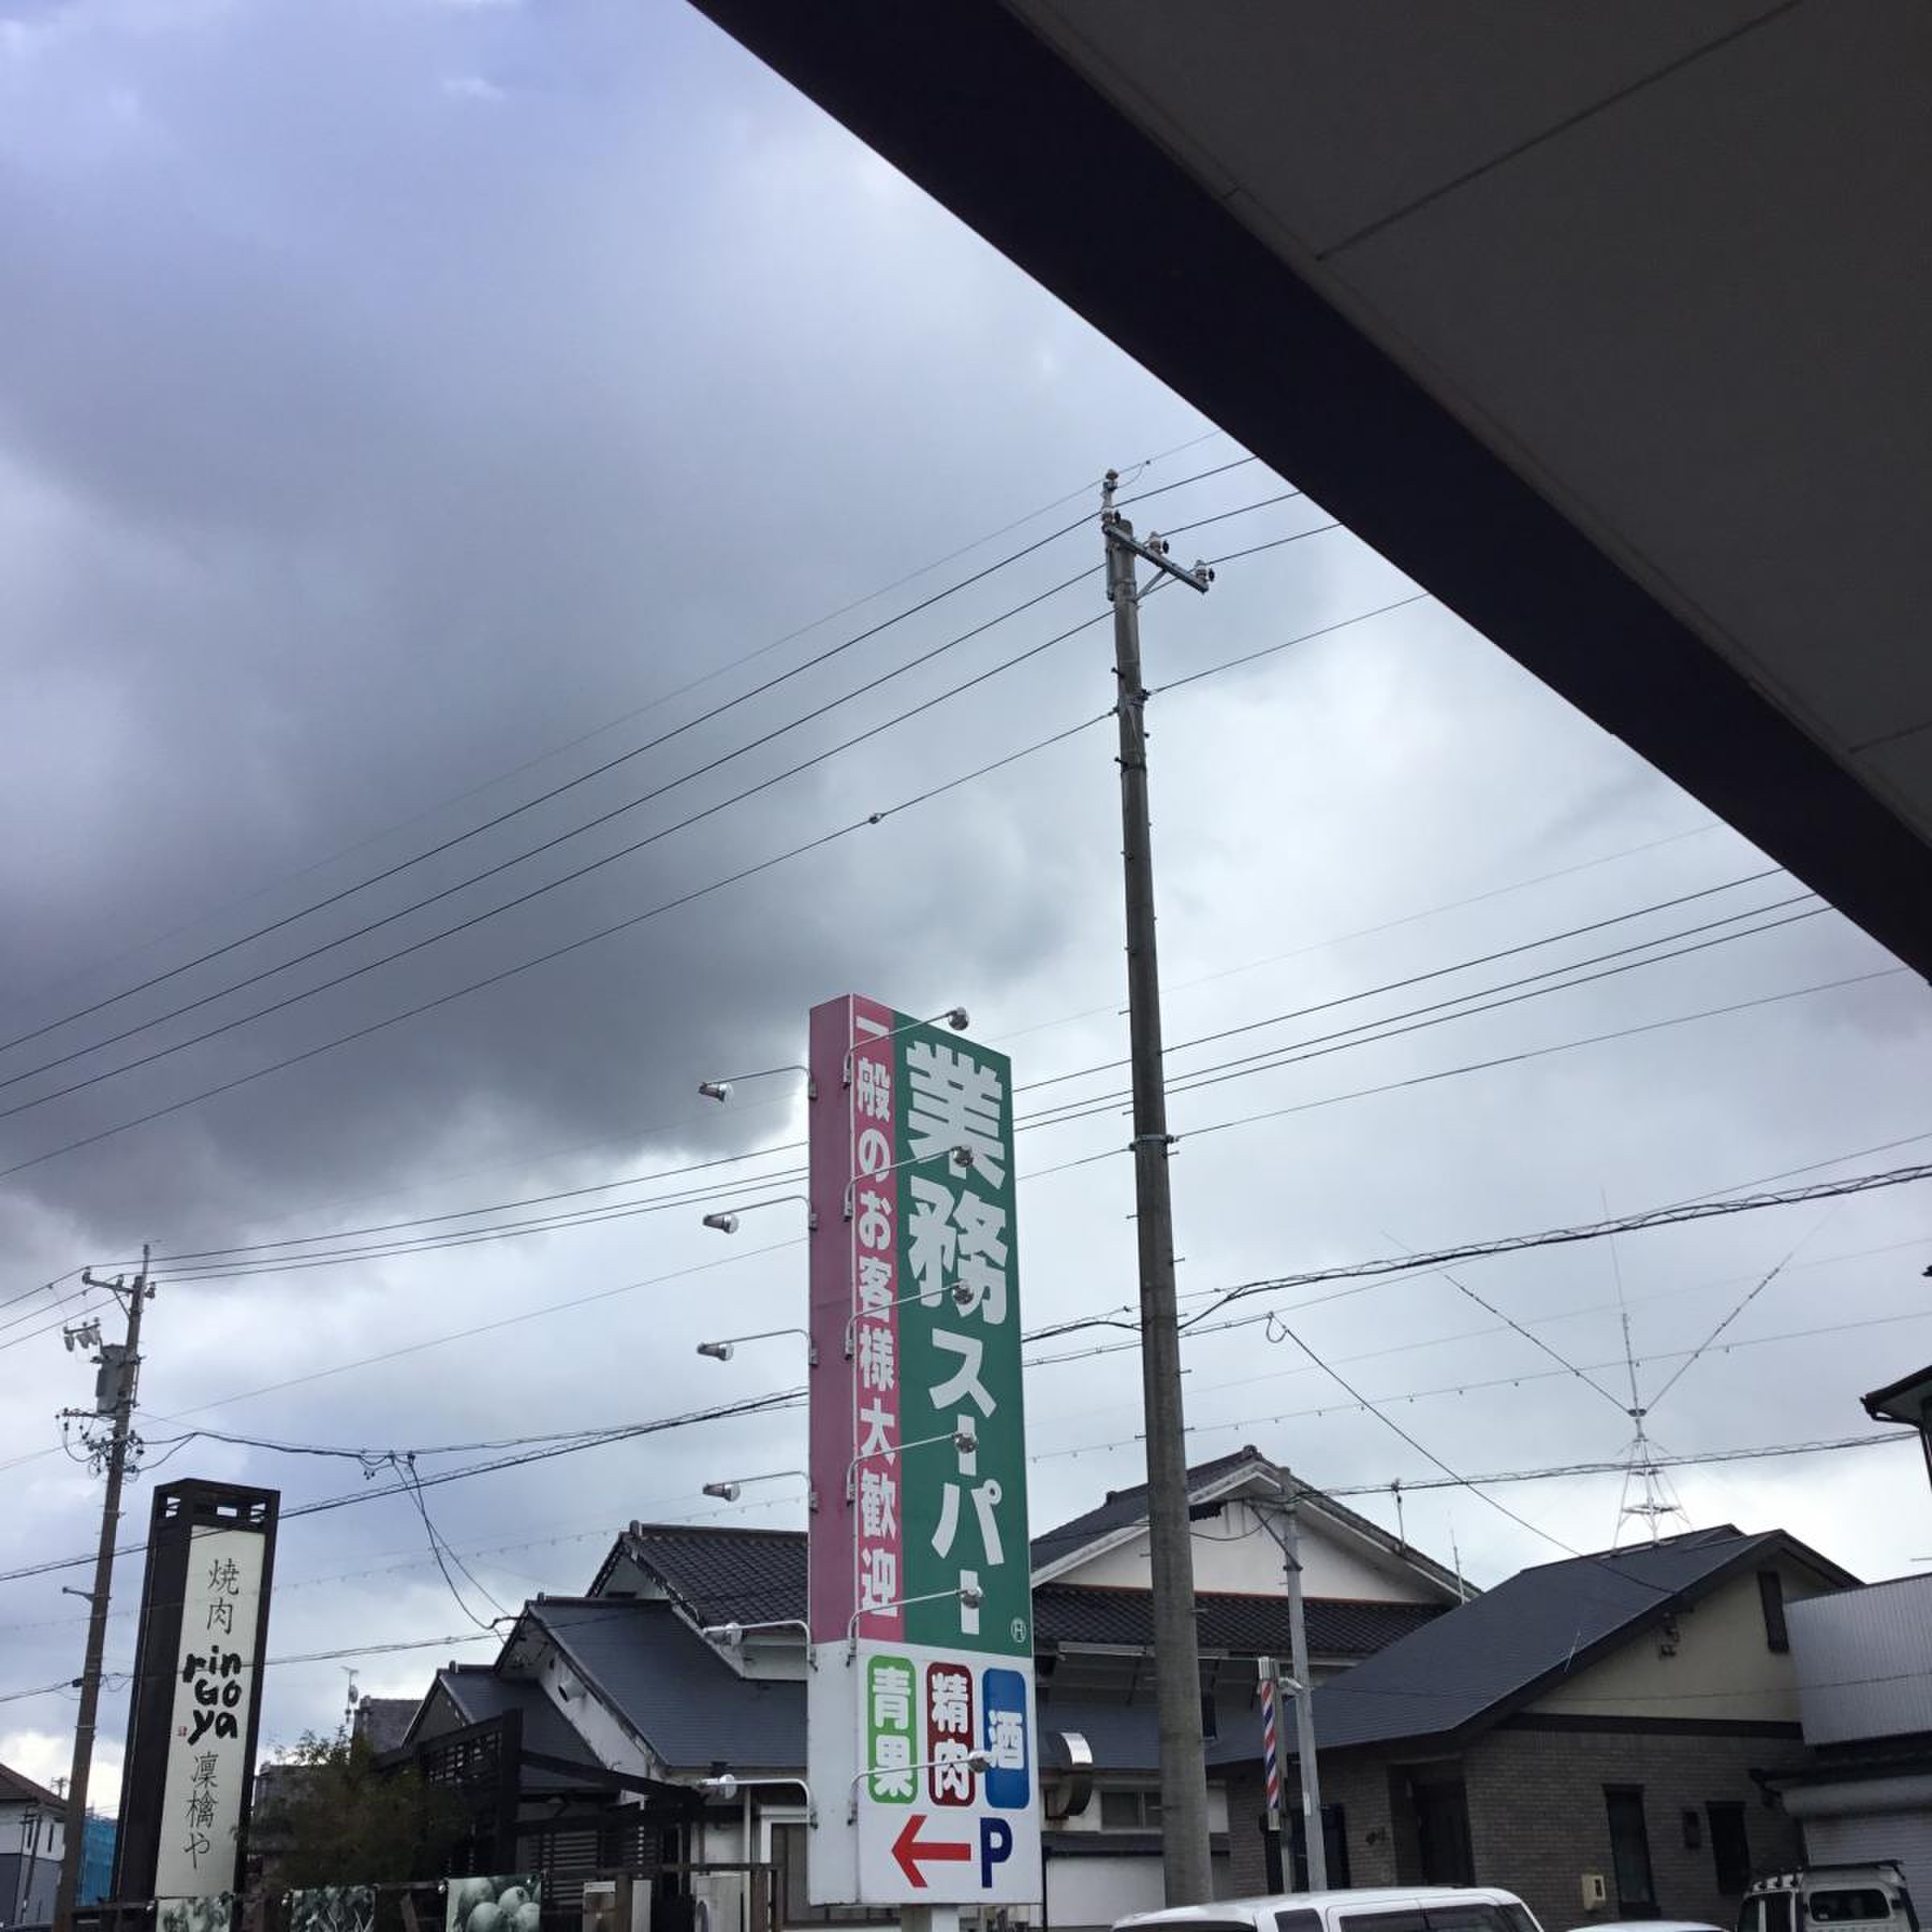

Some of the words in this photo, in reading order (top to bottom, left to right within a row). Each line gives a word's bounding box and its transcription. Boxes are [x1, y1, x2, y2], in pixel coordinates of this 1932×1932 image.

[856, 1015, 898, 1617] 一般のお客様大歓迎
[906, 1040, 1008, 1635] 業務スーパー
[208, 1558, 240, 1634] 焼肉
[182, 1645, 242, 1683] rin
[188, 1709, 237, 1746] ya
[873, 1666, 913, 1798] 青果
[931, 1672, 969, 1800] 精肉
[989, 1711, 1024, 1769] 酒
[980, 1817, 1013, 1888] P
